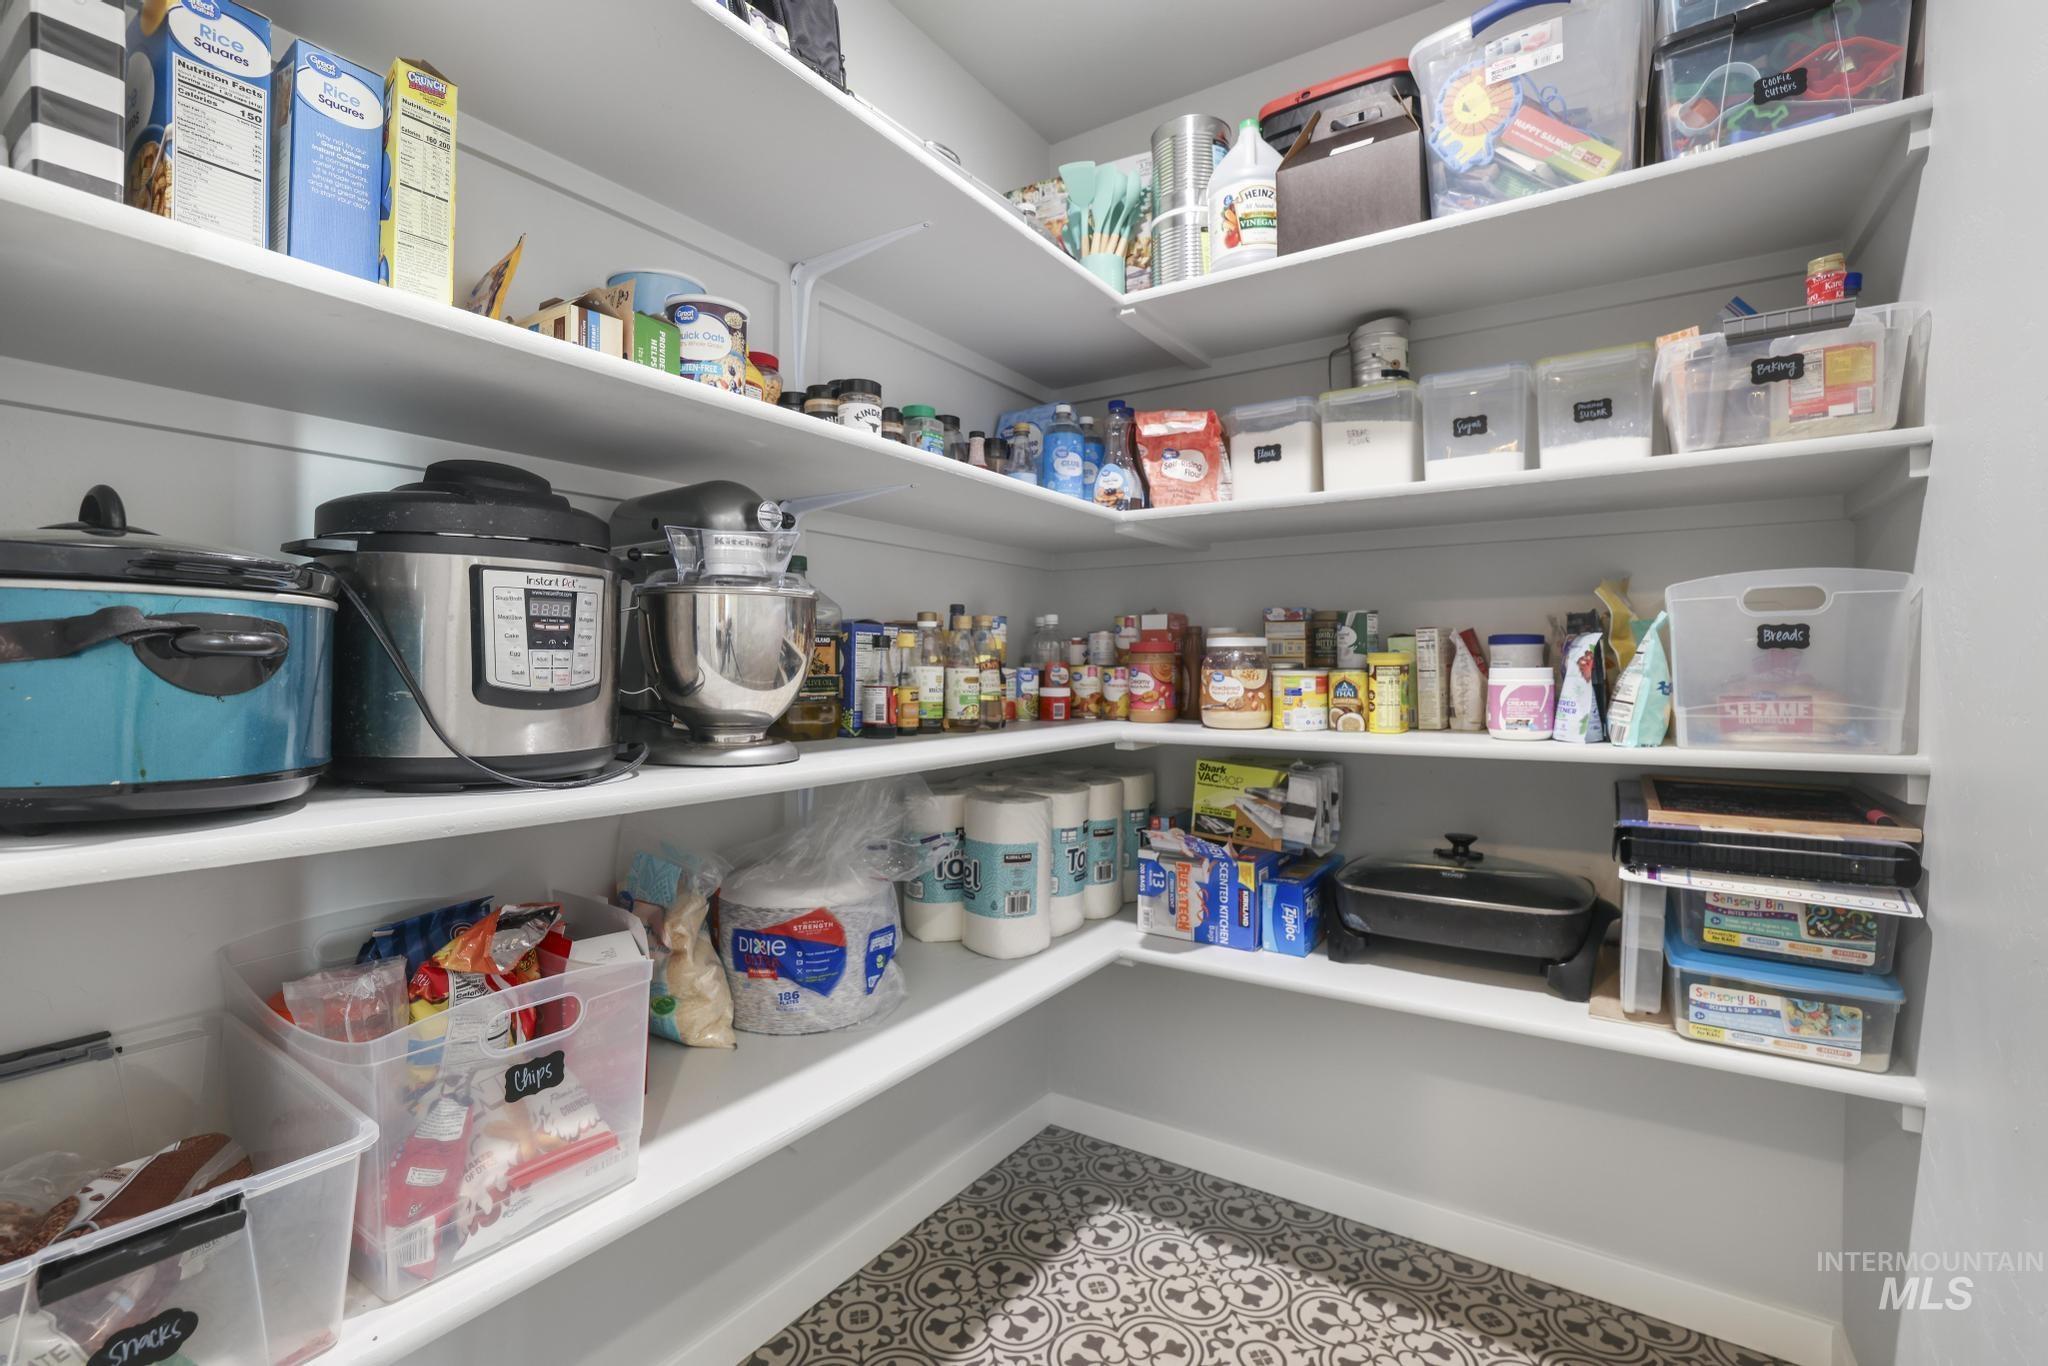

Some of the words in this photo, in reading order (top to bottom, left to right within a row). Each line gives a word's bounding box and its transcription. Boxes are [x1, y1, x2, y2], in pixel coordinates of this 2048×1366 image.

[200, 23, 244, 53] Rice
[194, 36, 250, 67] Squares
[310, 55, 335, 70] Great
[317, 63, 336, 76] Value
[178, 59, 229, 86] Nutrition
[232, 81, 263, 99] Facts
[408, 71, 447, 93] CRUNCH
[178, 88, 218, 107] Calories
[323, 81, 361, 107] Rice
[318, 94, 365, 120] Squares
[402, 98, 431, 115] Nutrition
[433, 110, 450, 124] Facts
[240, 110, 262, 123] 150
[401, 126, 421, 138] Calories
[1514, 119, 1541, 136] HAPPY
[1541, 131, 1573, 152] SALMON
[426, 135, 437, 145] 160
[438, 139, 450, 150] 200
[1244, 188, 1275, 199] HEINZ
[677, 310, 694, 319] Great
[703, 331, 725, 343] Oats
[680, 363, 718, 373] UTEN-FREE
[715, 537, 771, 548] Kitchen
[526, 575, 559, 587] Instant
[562, 578, 576, 588] Pot
[1763, 628, 1804, 642] Breads
[1724, 702, 1809, 717] SESAME
[1199, 763, 1226, 774] Shark
[1153, 871, 1164, 888] 13
[1219, 862, 1228, 904] SCENTED
[1712, 892, 1761, 909] Sensory
[1765, 900, 1784, 910] Bin
[793, 922, 833, 931] STRENGTH
[1219, 905, 1229, 945] KITCHEN
[1282, 907, 1297, 942] Ziploc
[778, 991, 800, 1001] 186
[1695, 987, 1744, 1005] Sensory
[1748, 995, 1767, 1007] Bin
[1708, 1005, 1727, 1013] OCEAN
[514, 1063, 553, 1092] Chips
[108, 1318, 182, 1366] Snacks
